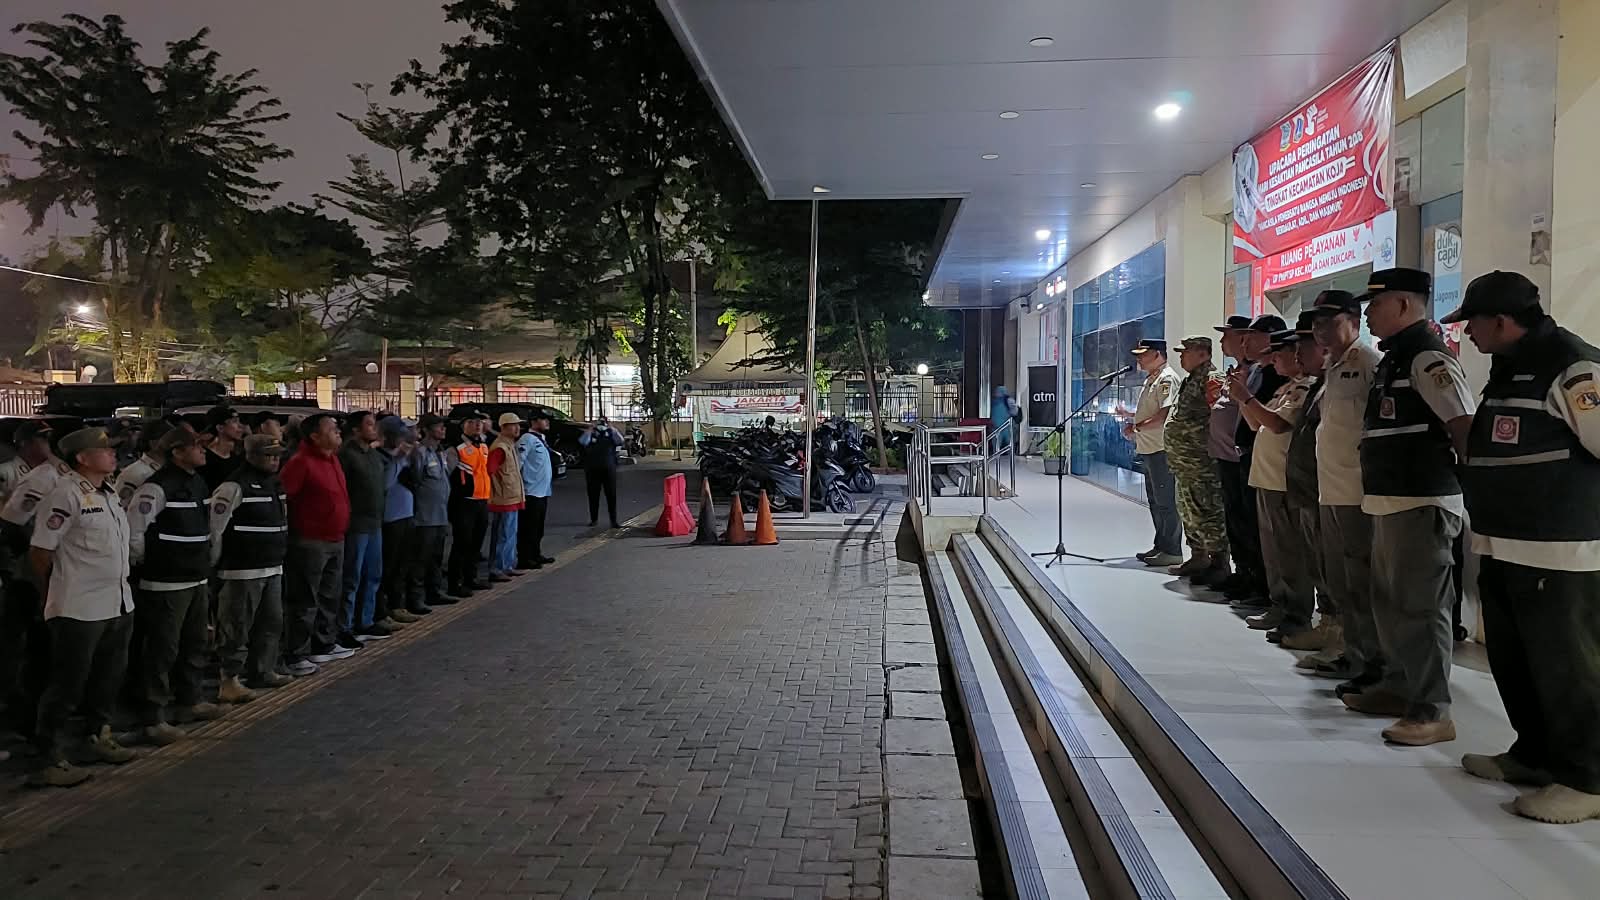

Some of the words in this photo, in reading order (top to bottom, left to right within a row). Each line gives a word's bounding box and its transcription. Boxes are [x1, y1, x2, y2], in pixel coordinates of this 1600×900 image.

[1269, 150, 1296, 176] UPACARA
[1297, 124, 1340, 161] PERINGATAN
[1268, 166, 1294, 189] KESAKTIAN
[1295, 150, 1326, 175] PANCASILA
[1325, 137, 1348, 160] TAHUN
[1266, 188, 1288, 209] TINGKAT
[1288, 171, 1325, 198] KECAMATAN
[1325, 161, 1344, 182] KOJA
[1280, 248, 1303, 268] RUANG
[1304, 232, 1346, 260] PELAYANAN
[1437, 232, 1454, 249] duk
[1330, 249, 1356, 266] DUKCAPIL
[1438, 243, 1458, 264] capil
[735, 396, 788, 404] JAKARTA
[1033, 391, 1056, 402] atm
